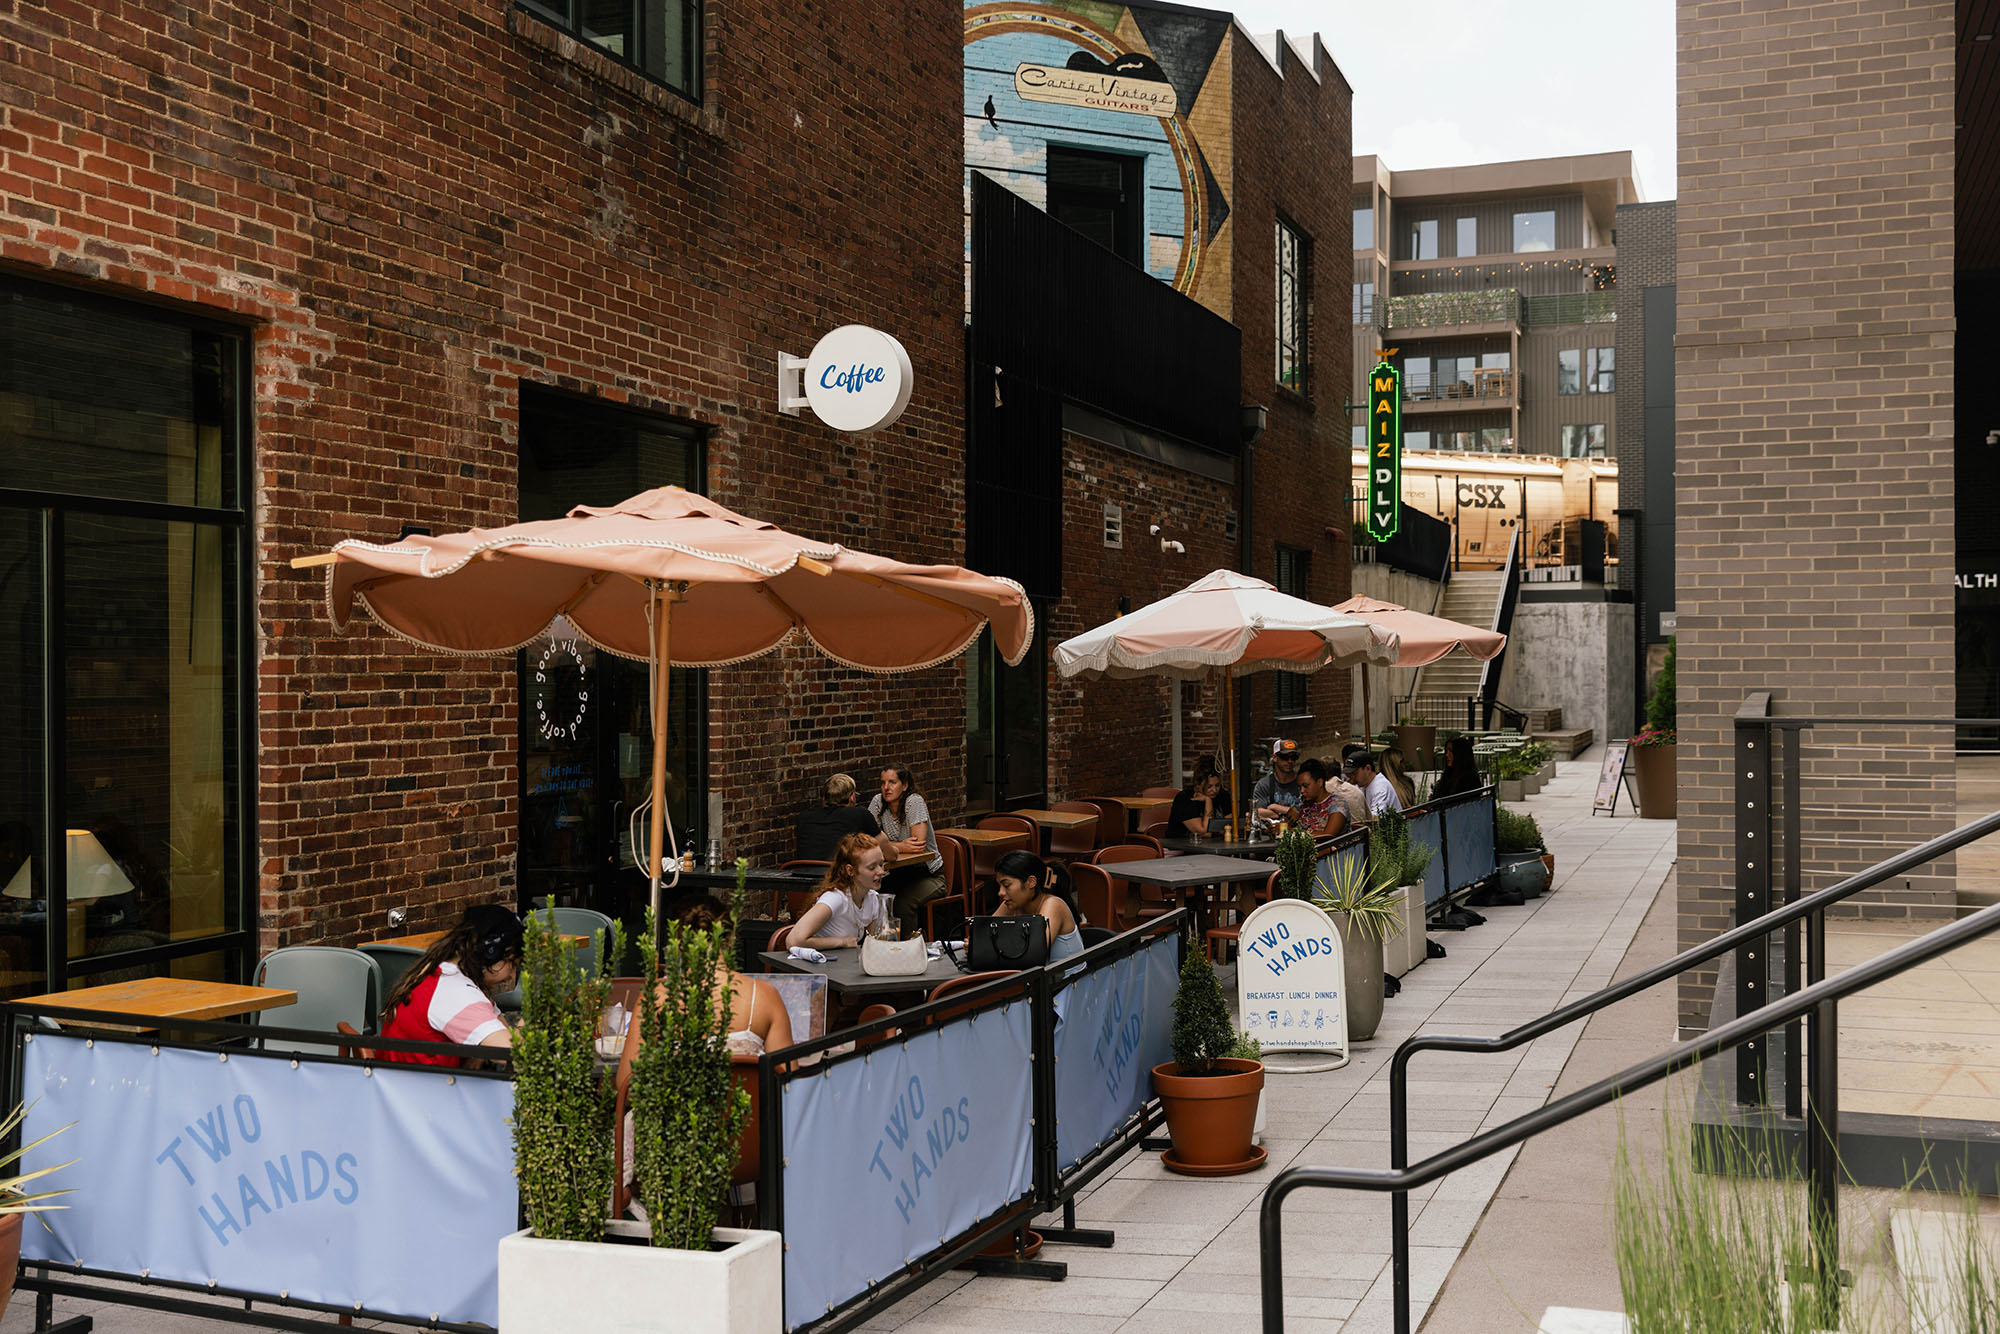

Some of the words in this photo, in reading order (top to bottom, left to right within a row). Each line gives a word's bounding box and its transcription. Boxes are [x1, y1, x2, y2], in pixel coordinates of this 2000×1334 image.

[1020, 68, 1099, 94] Carter
[1101, 78, 1174, 105] Vintage
[1085, 97, 1150, 112] GUITARS
[820, 363, 886, 394] Coffee
[1375, 377, 1394, 458] MAIZ
[1375, 468, 1393, 528] DLV
[1457, 483, 1506, 509] CSX
[536, 635, 557, 683] good
[570, 691, 588, 741] good
[1247, 922, 1290, 958] TWO
[1266, 937, 1333, 976] HANDS
[1246, 991, 1285, 1000] BREAKFAST
[1288, 991, 1311, 1000] LUNCH
[1314, 991, 1338, 999] DINNER
[1093, 988, 1122, 1069] TWO
[1260, 1039, 1338, 1048] w.twohandshospitality.com
[156, 1094, 261, 1187] TWO
[868, 1074, 925, 1183] TWO
[894, 1097, 970, 1225] HANDS
[199, 1150, 359, 1247] HANDS
